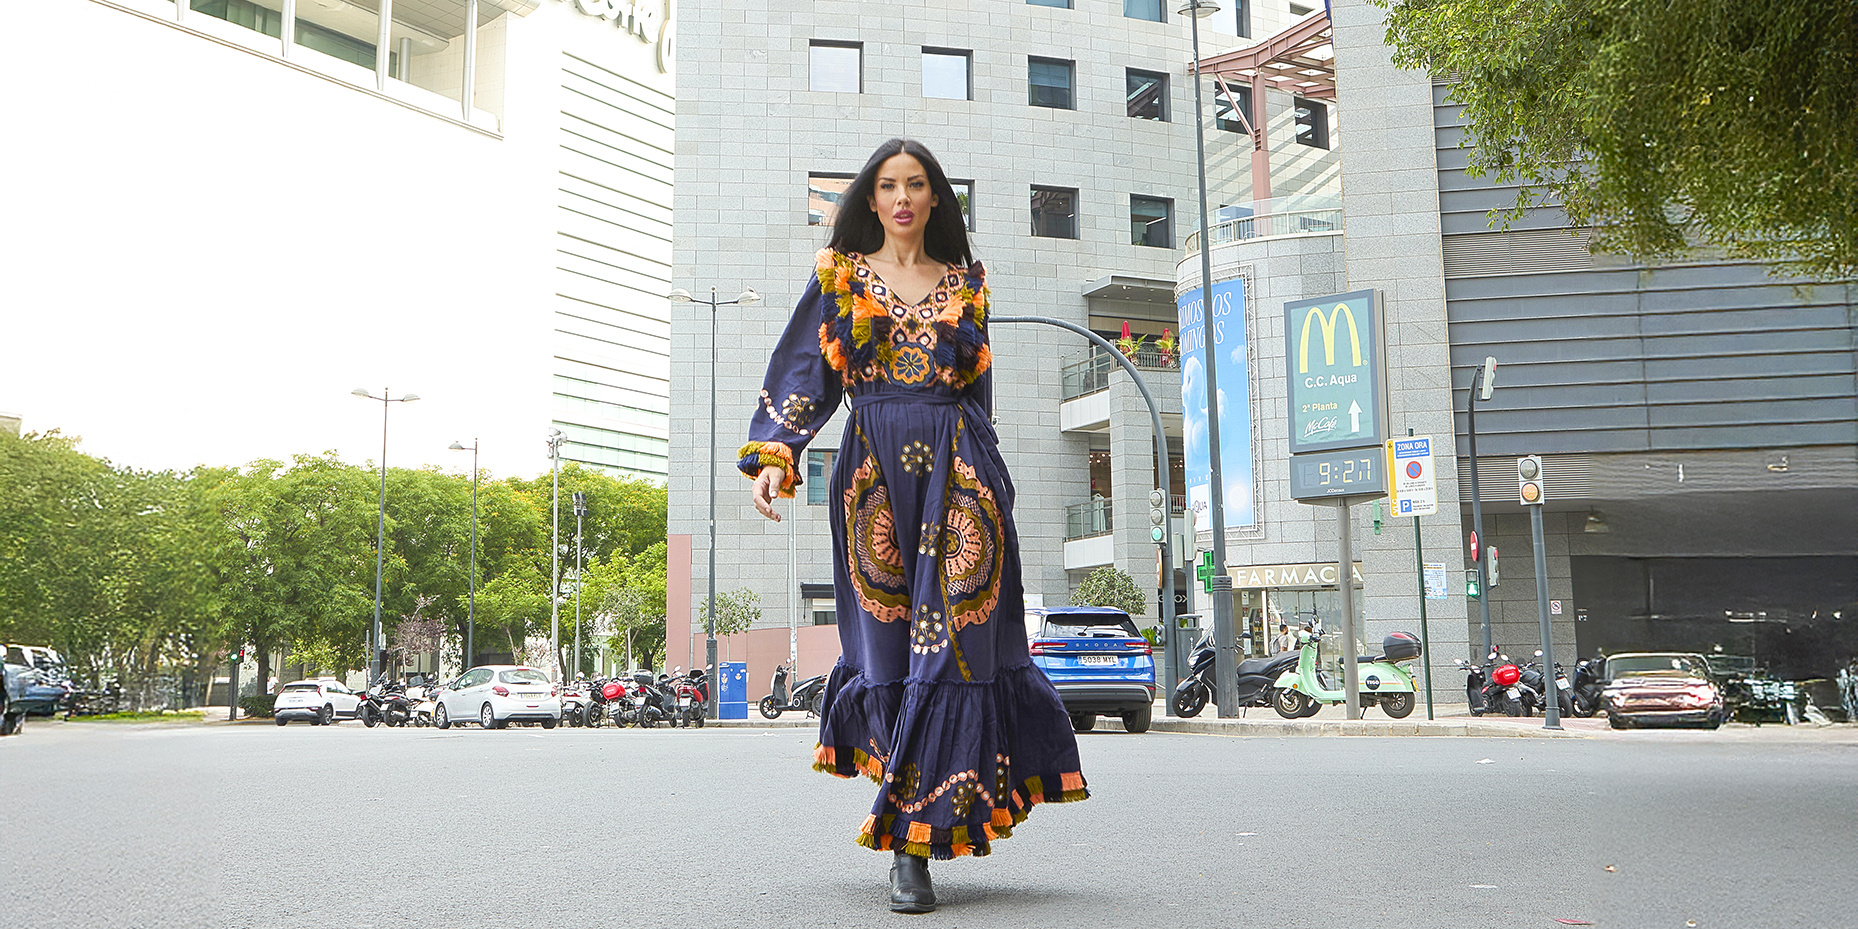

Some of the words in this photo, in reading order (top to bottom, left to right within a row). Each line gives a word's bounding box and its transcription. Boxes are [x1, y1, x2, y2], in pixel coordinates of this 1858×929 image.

[1211, 291, 1232, 317] OS
[1304, 376, 1328, 389] C.C.
[1329, 374, 1357, 387] Aqua
[1312, 402, 1338, 412] Planta
[1397, 443, 1414, 451] ZONA
[1414, 441, 1428, 450] ORA
[1083, 656, 1101, 664] 5038
